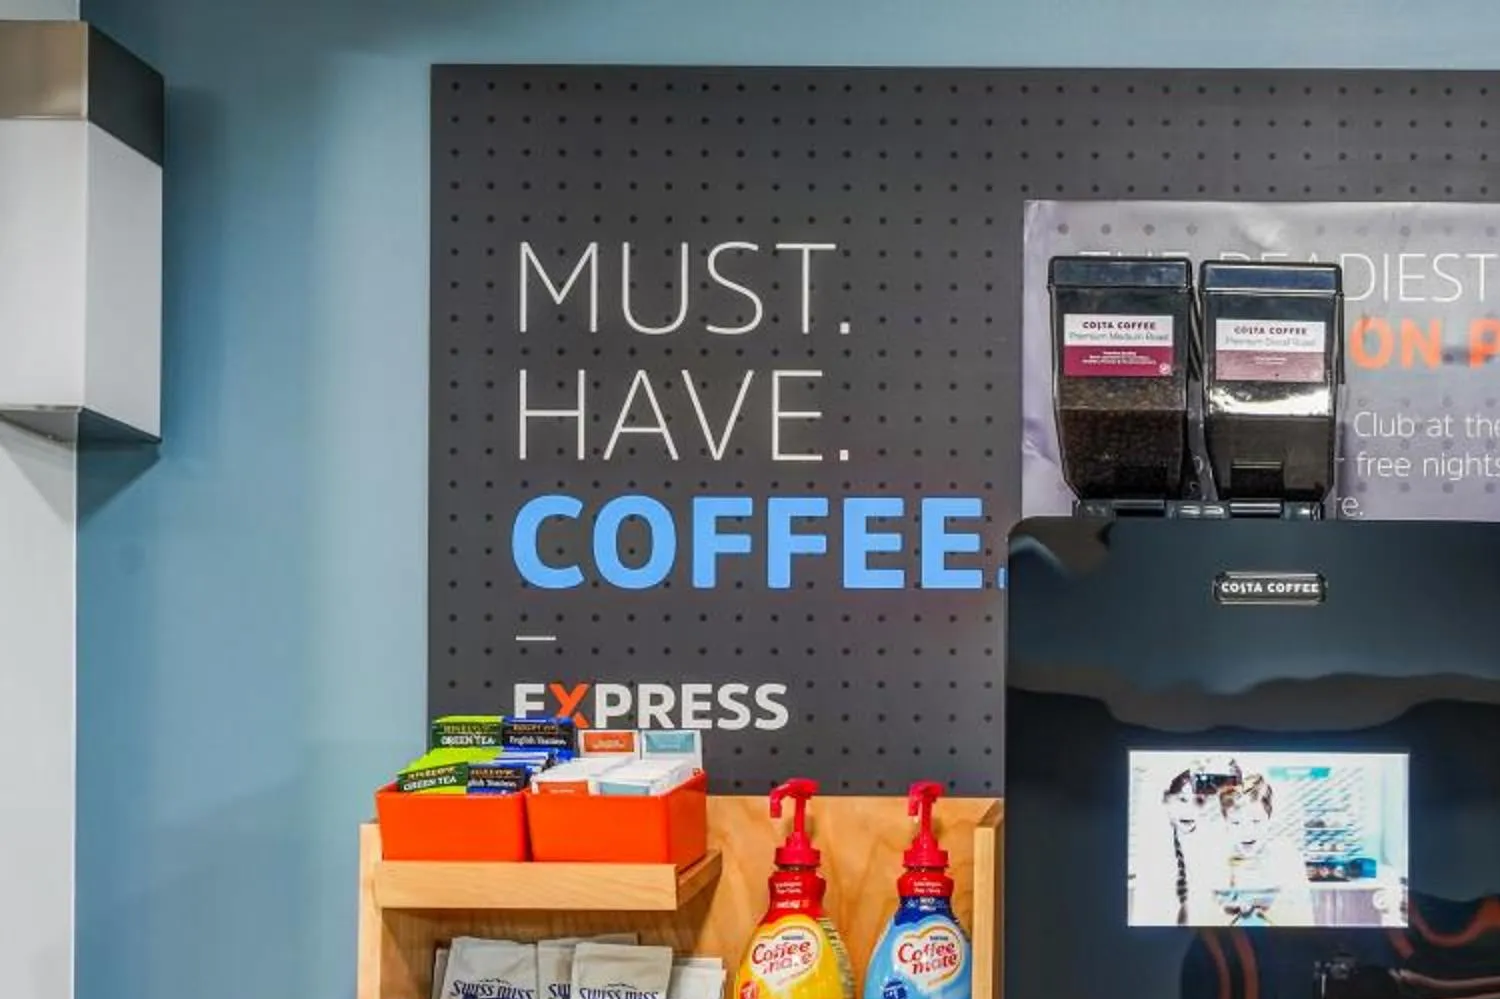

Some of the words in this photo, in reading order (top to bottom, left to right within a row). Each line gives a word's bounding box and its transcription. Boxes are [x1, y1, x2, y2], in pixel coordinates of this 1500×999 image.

[520, 241, 849, 335] MUST.
[1220, 253, 1499, 302] DIEST
[1117, 321, 1156, 331] COFFEE
[1269, 326, 1307, 335] COFFEE
[1350, 318, 1442, 371] ON
[519, 369, 849, 461] HAVE.
[1353, 411, 1416, 439] Club
[1426, 415, 1454, 438] at
[1356, 452, 1412, 479] free
[511, 494, 1006, 590] COFFEE
[1221, 582, 1263, 594] COSTA
[1267, 583, 1320, 593] COFFEE
[513, 682, 790, 731] EXPRESS
